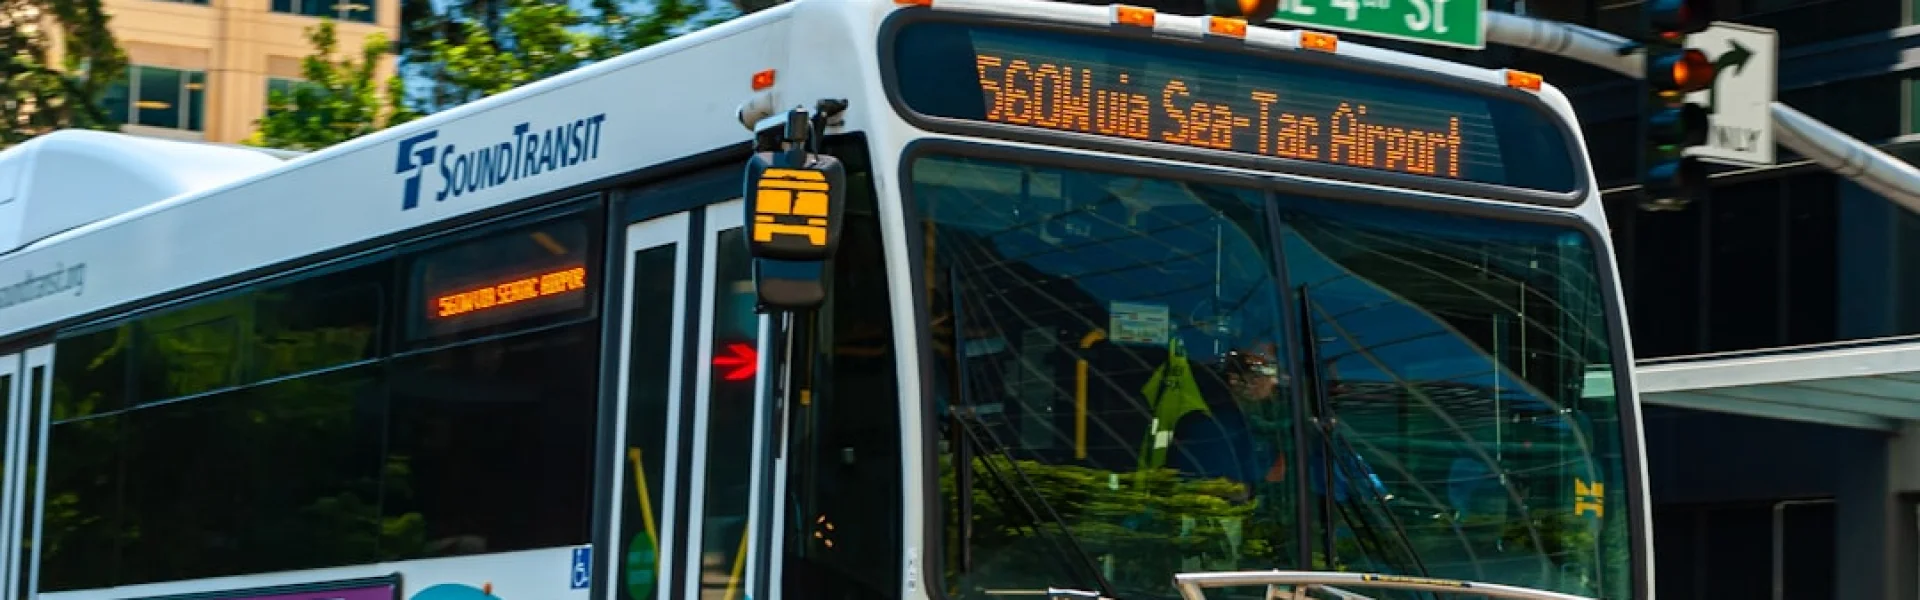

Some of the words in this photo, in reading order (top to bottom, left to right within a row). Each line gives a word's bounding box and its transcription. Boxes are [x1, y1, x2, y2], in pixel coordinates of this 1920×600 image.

[976, 54, 1091, 131] 560W
[1161, 79, 1319, 160] Sea-Tac
[1329, 101, 1462, 178] Airport
[1709, 126, 1763, 154] NLY
